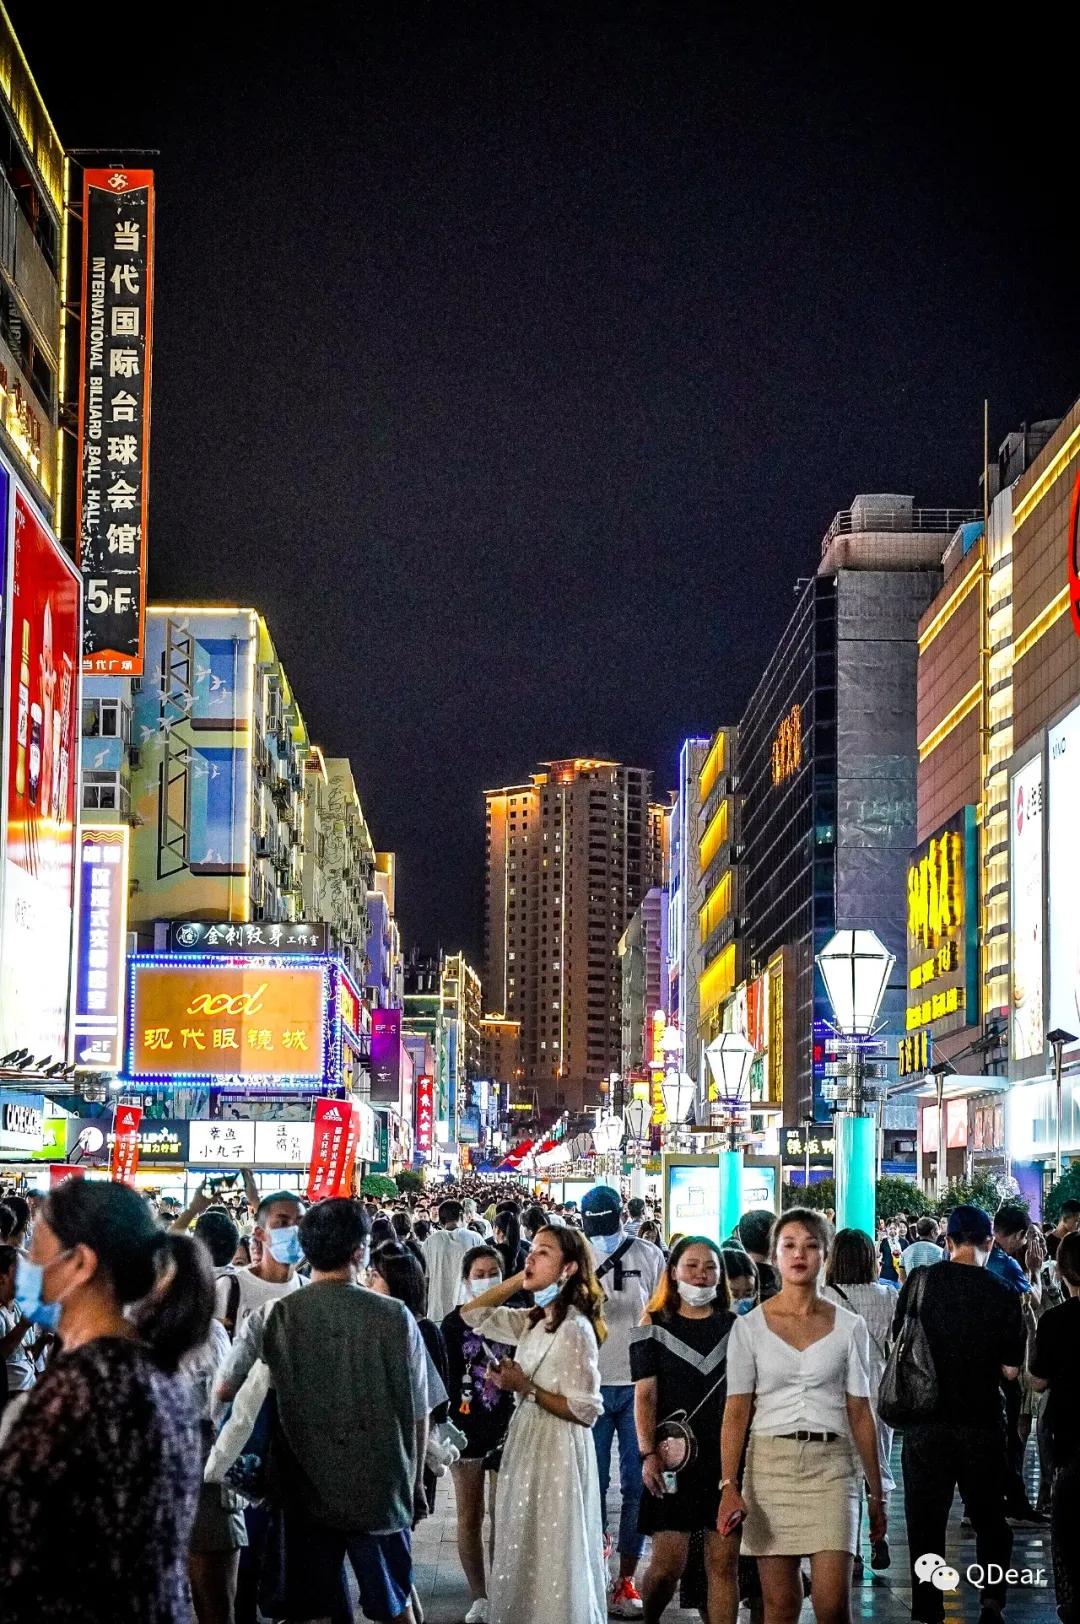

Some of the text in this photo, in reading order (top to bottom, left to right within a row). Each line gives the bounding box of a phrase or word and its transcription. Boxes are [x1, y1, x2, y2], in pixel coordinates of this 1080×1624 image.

[86, 256, 105, 530] INTERNATIONAL BILLIARD BALL HALL
[107, 220, 140, 554] 当代国际台球会馆
[88, 579, 132, 615] 5F
[91, 1040, 111, 1053] 2F
[143, 1027, 310, 1052] 现代眼镜城
[199, 1145, 245, 1158] 小丸子
